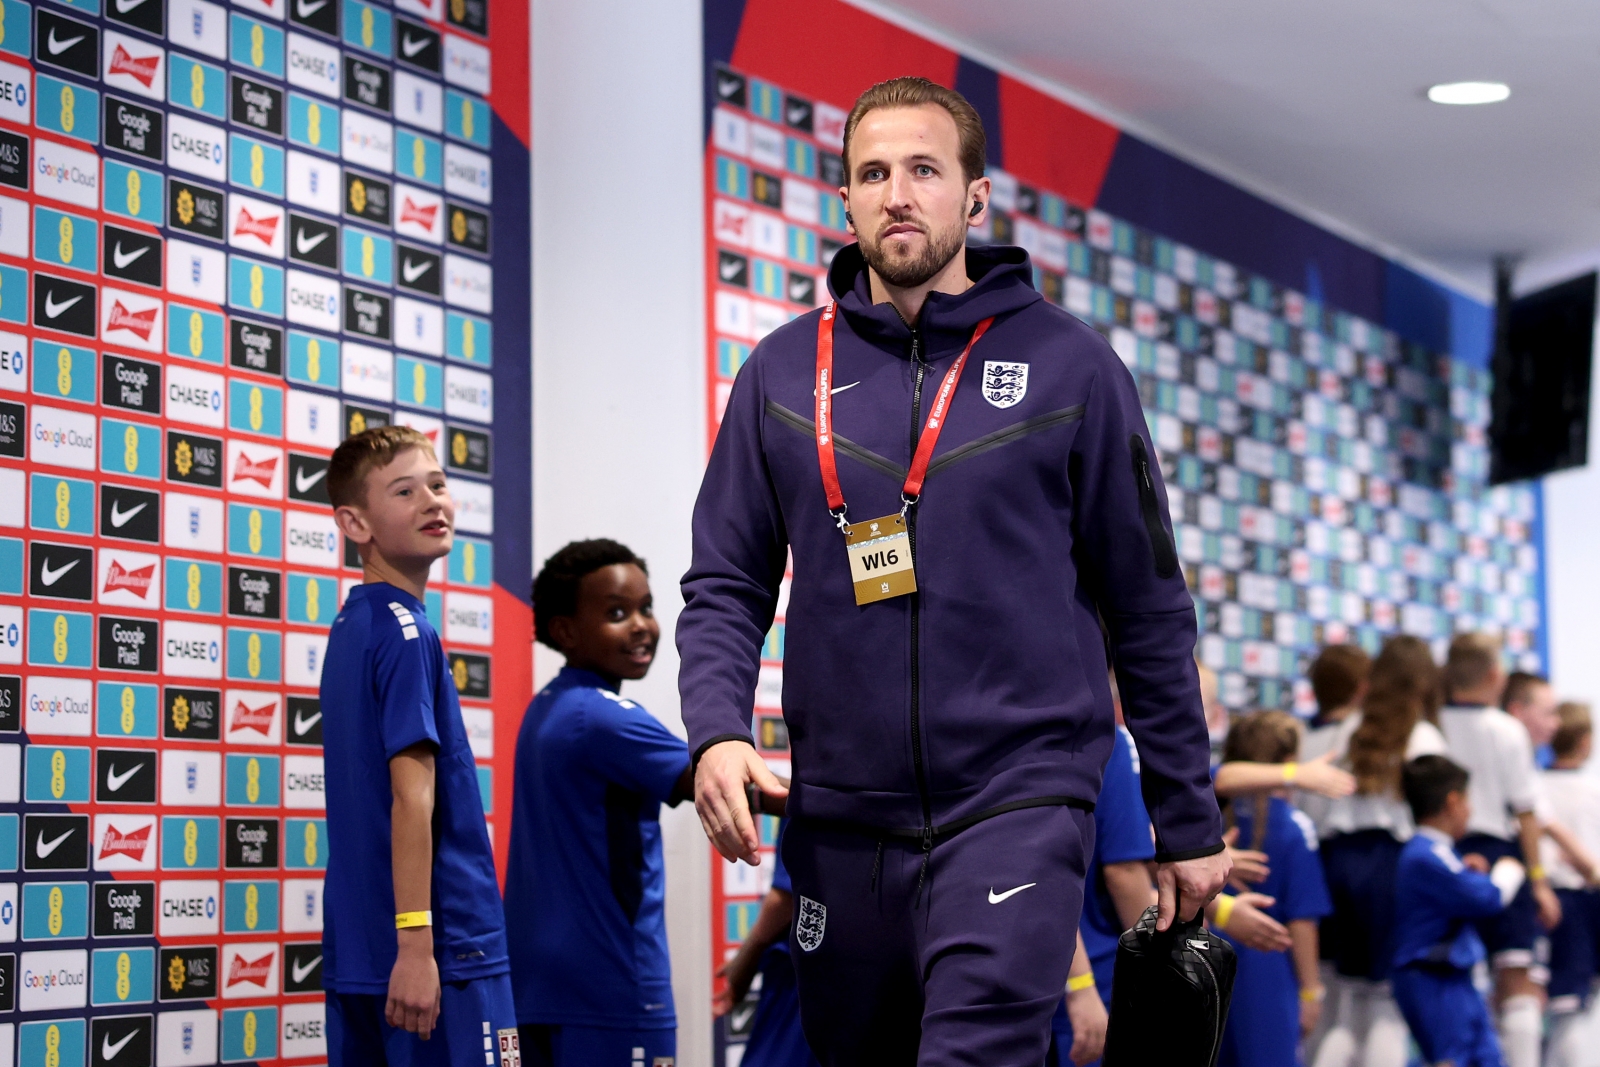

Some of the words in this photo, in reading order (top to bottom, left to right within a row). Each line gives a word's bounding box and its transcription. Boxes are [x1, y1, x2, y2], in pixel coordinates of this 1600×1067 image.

[118, 106, 151, 133] Google
[171, 133, 211, 160] CHASE
[38, 157, 69, 184] Google
[70, 170, 96, 188] Cloud
[115, 363, 149, 388] Google
[121, 387, 143, 406] Pixel
[170, 384, 209, 408] CHASE
[934, 384, 951, 418] EUROPEAN
[820, 401, 828, 434] EUROPEAN
[35, 423, 66, 447] Google
[68, 430, 92, 448] Cloud
[112, 623, 145, 649] Google
[118, 648, 140, 665] Pixel
[167, 640, 206, 660] CHASE
[30, 694, 62, 717] Google
[64, 696, 89, 715] Cloud
[237, 823, 268, 847] Google
[108, 889, 141, 912] Google
[163, 899, 204, 918] CHASE
[113, 911, 135, 930] Pixel
[24, 969, 57, 992] Google
[58, 969, 84, 987] Cloud
[285, 1020, 321, 1040] CHASE
